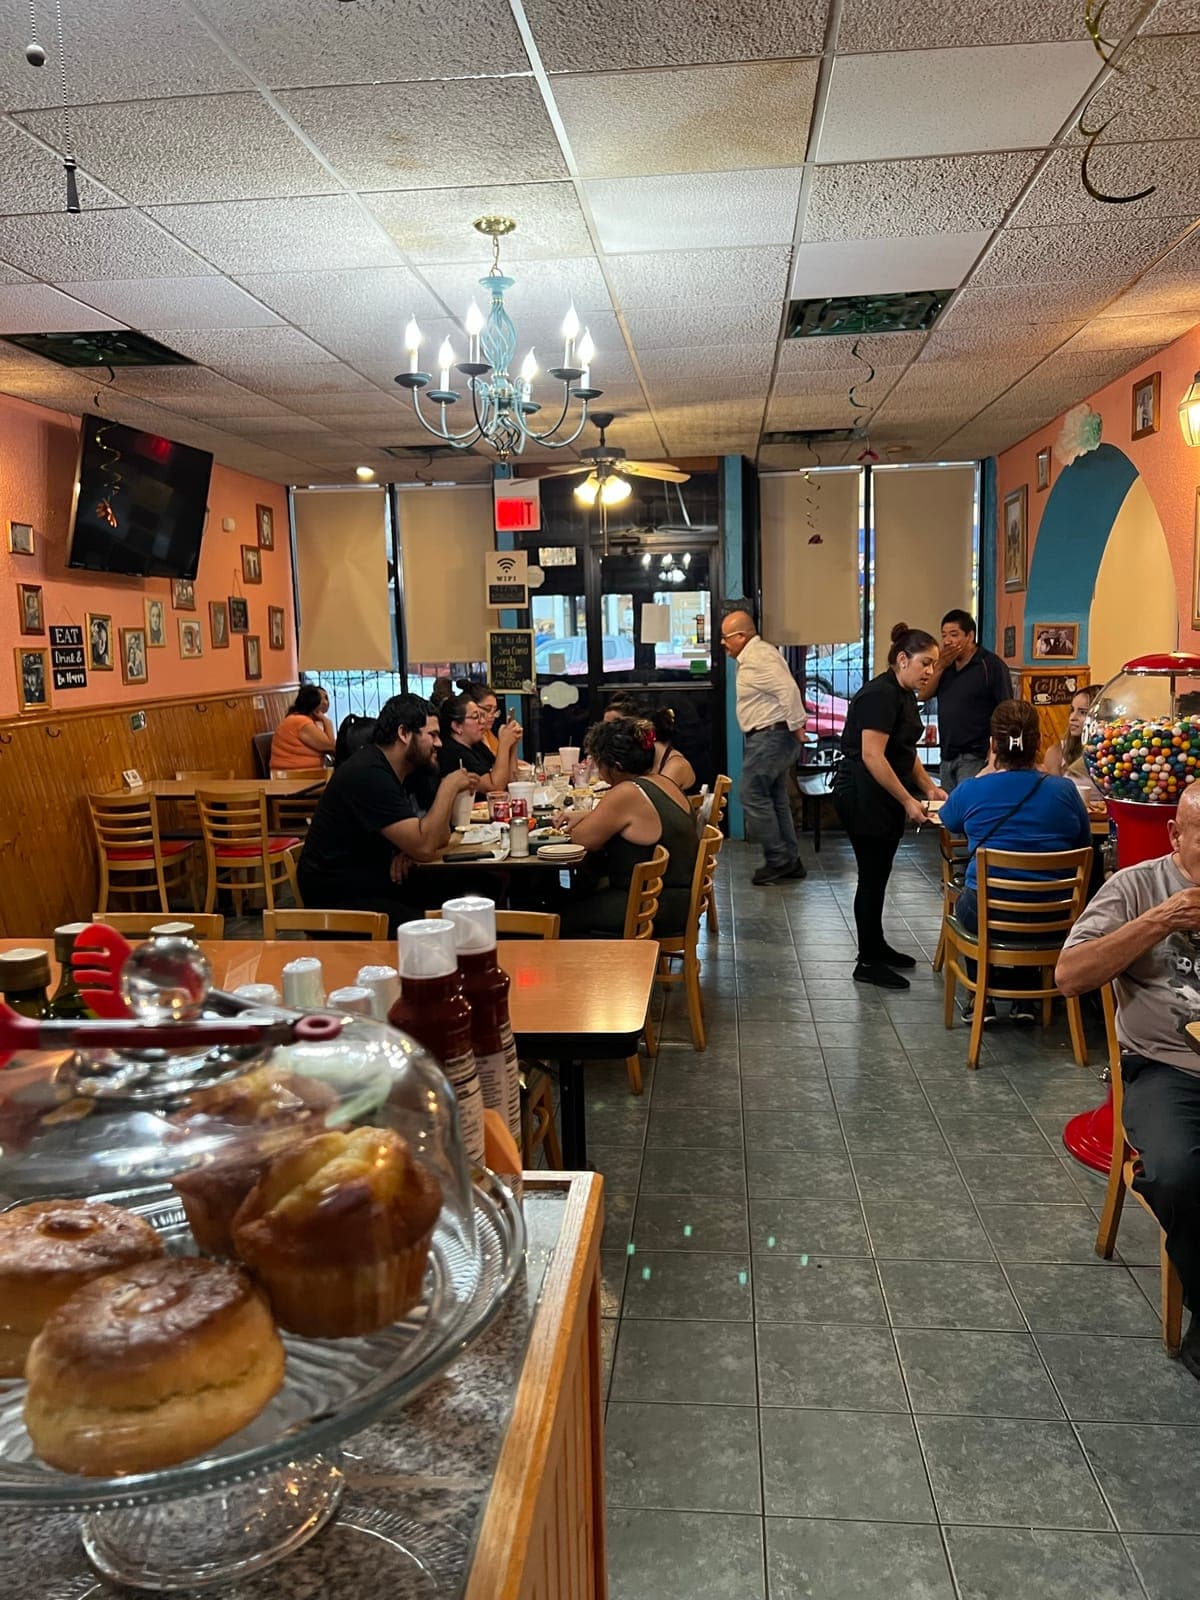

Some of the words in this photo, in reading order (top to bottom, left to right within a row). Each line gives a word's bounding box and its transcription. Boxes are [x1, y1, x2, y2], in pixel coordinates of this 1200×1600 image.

[499, 501, 533, 526] XIT
[55, 628, 79, 644] EAT
[55, 650, 76, 664] Drink
[76, 650, 83, 663] &
